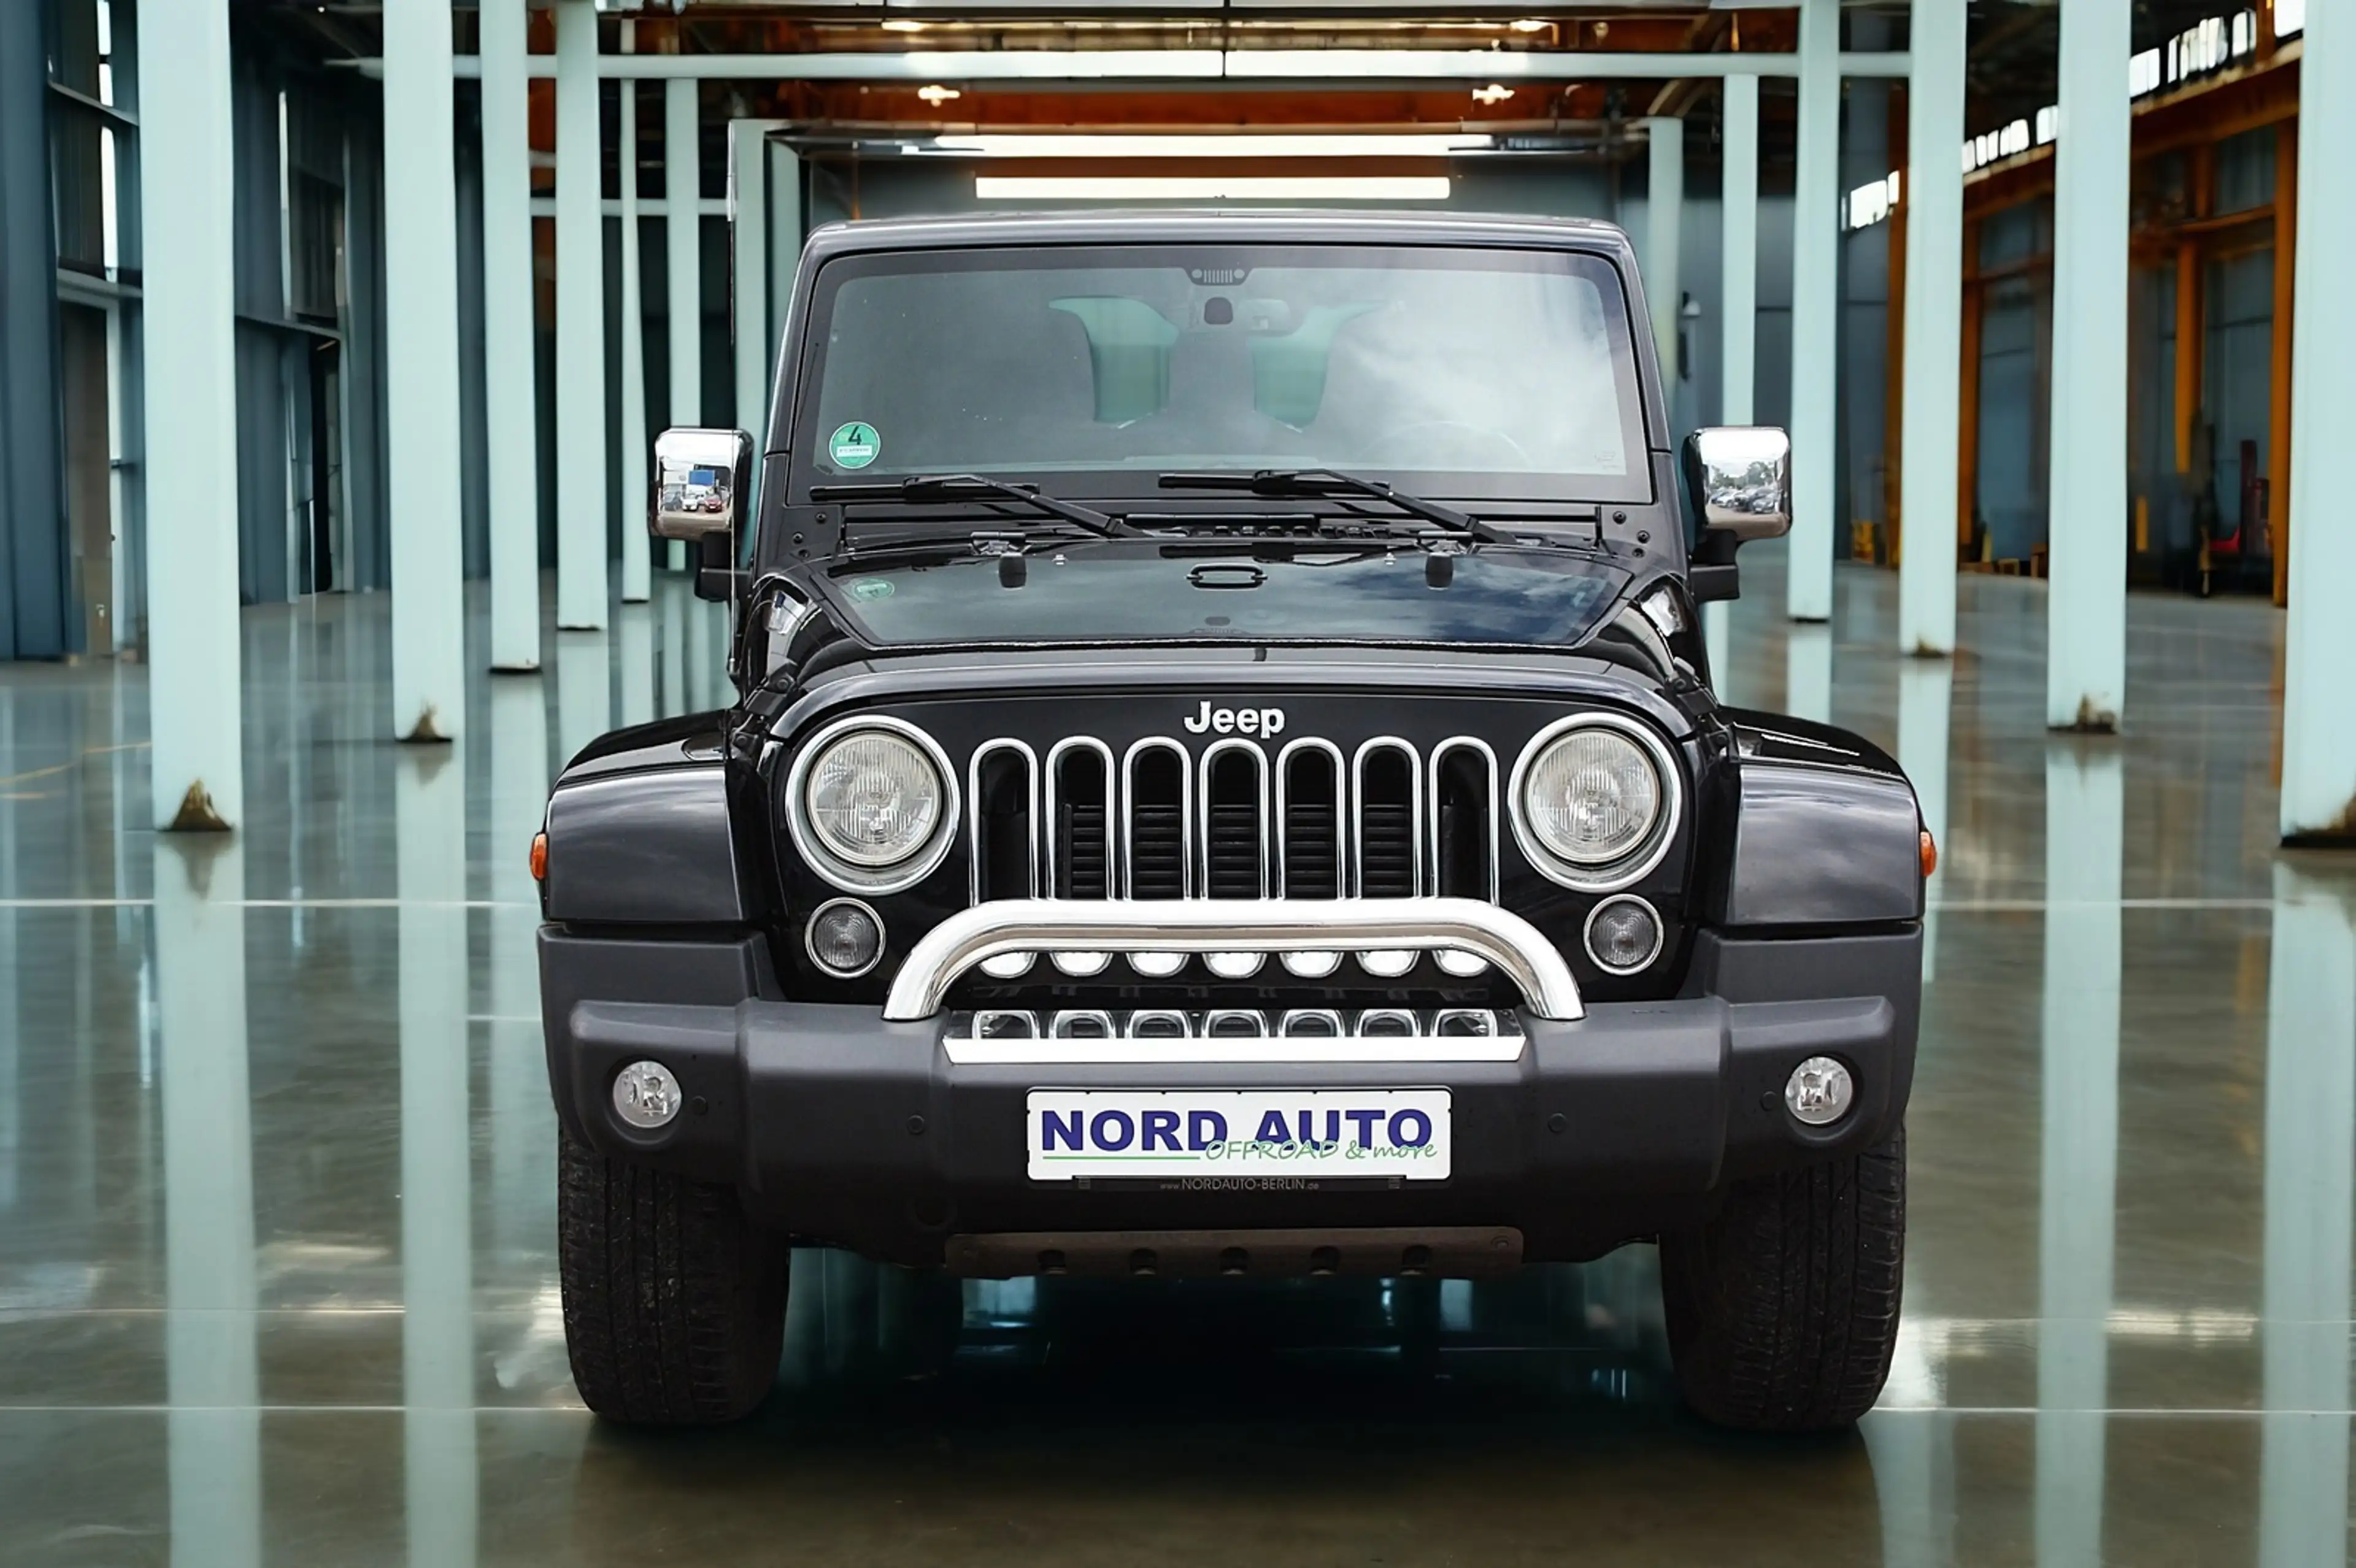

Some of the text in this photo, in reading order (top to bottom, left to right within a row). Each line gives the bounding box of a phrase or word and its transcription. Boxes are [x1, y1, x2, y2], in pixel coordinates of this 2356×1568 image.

[848, 425, 861, 445] 4
[1184, 701, 1285, 739] Jeep
[1042, 1109, 1432, 1151] NORD AUTO
[1206, 1139, 1438, 1160] OFFROAD & more
